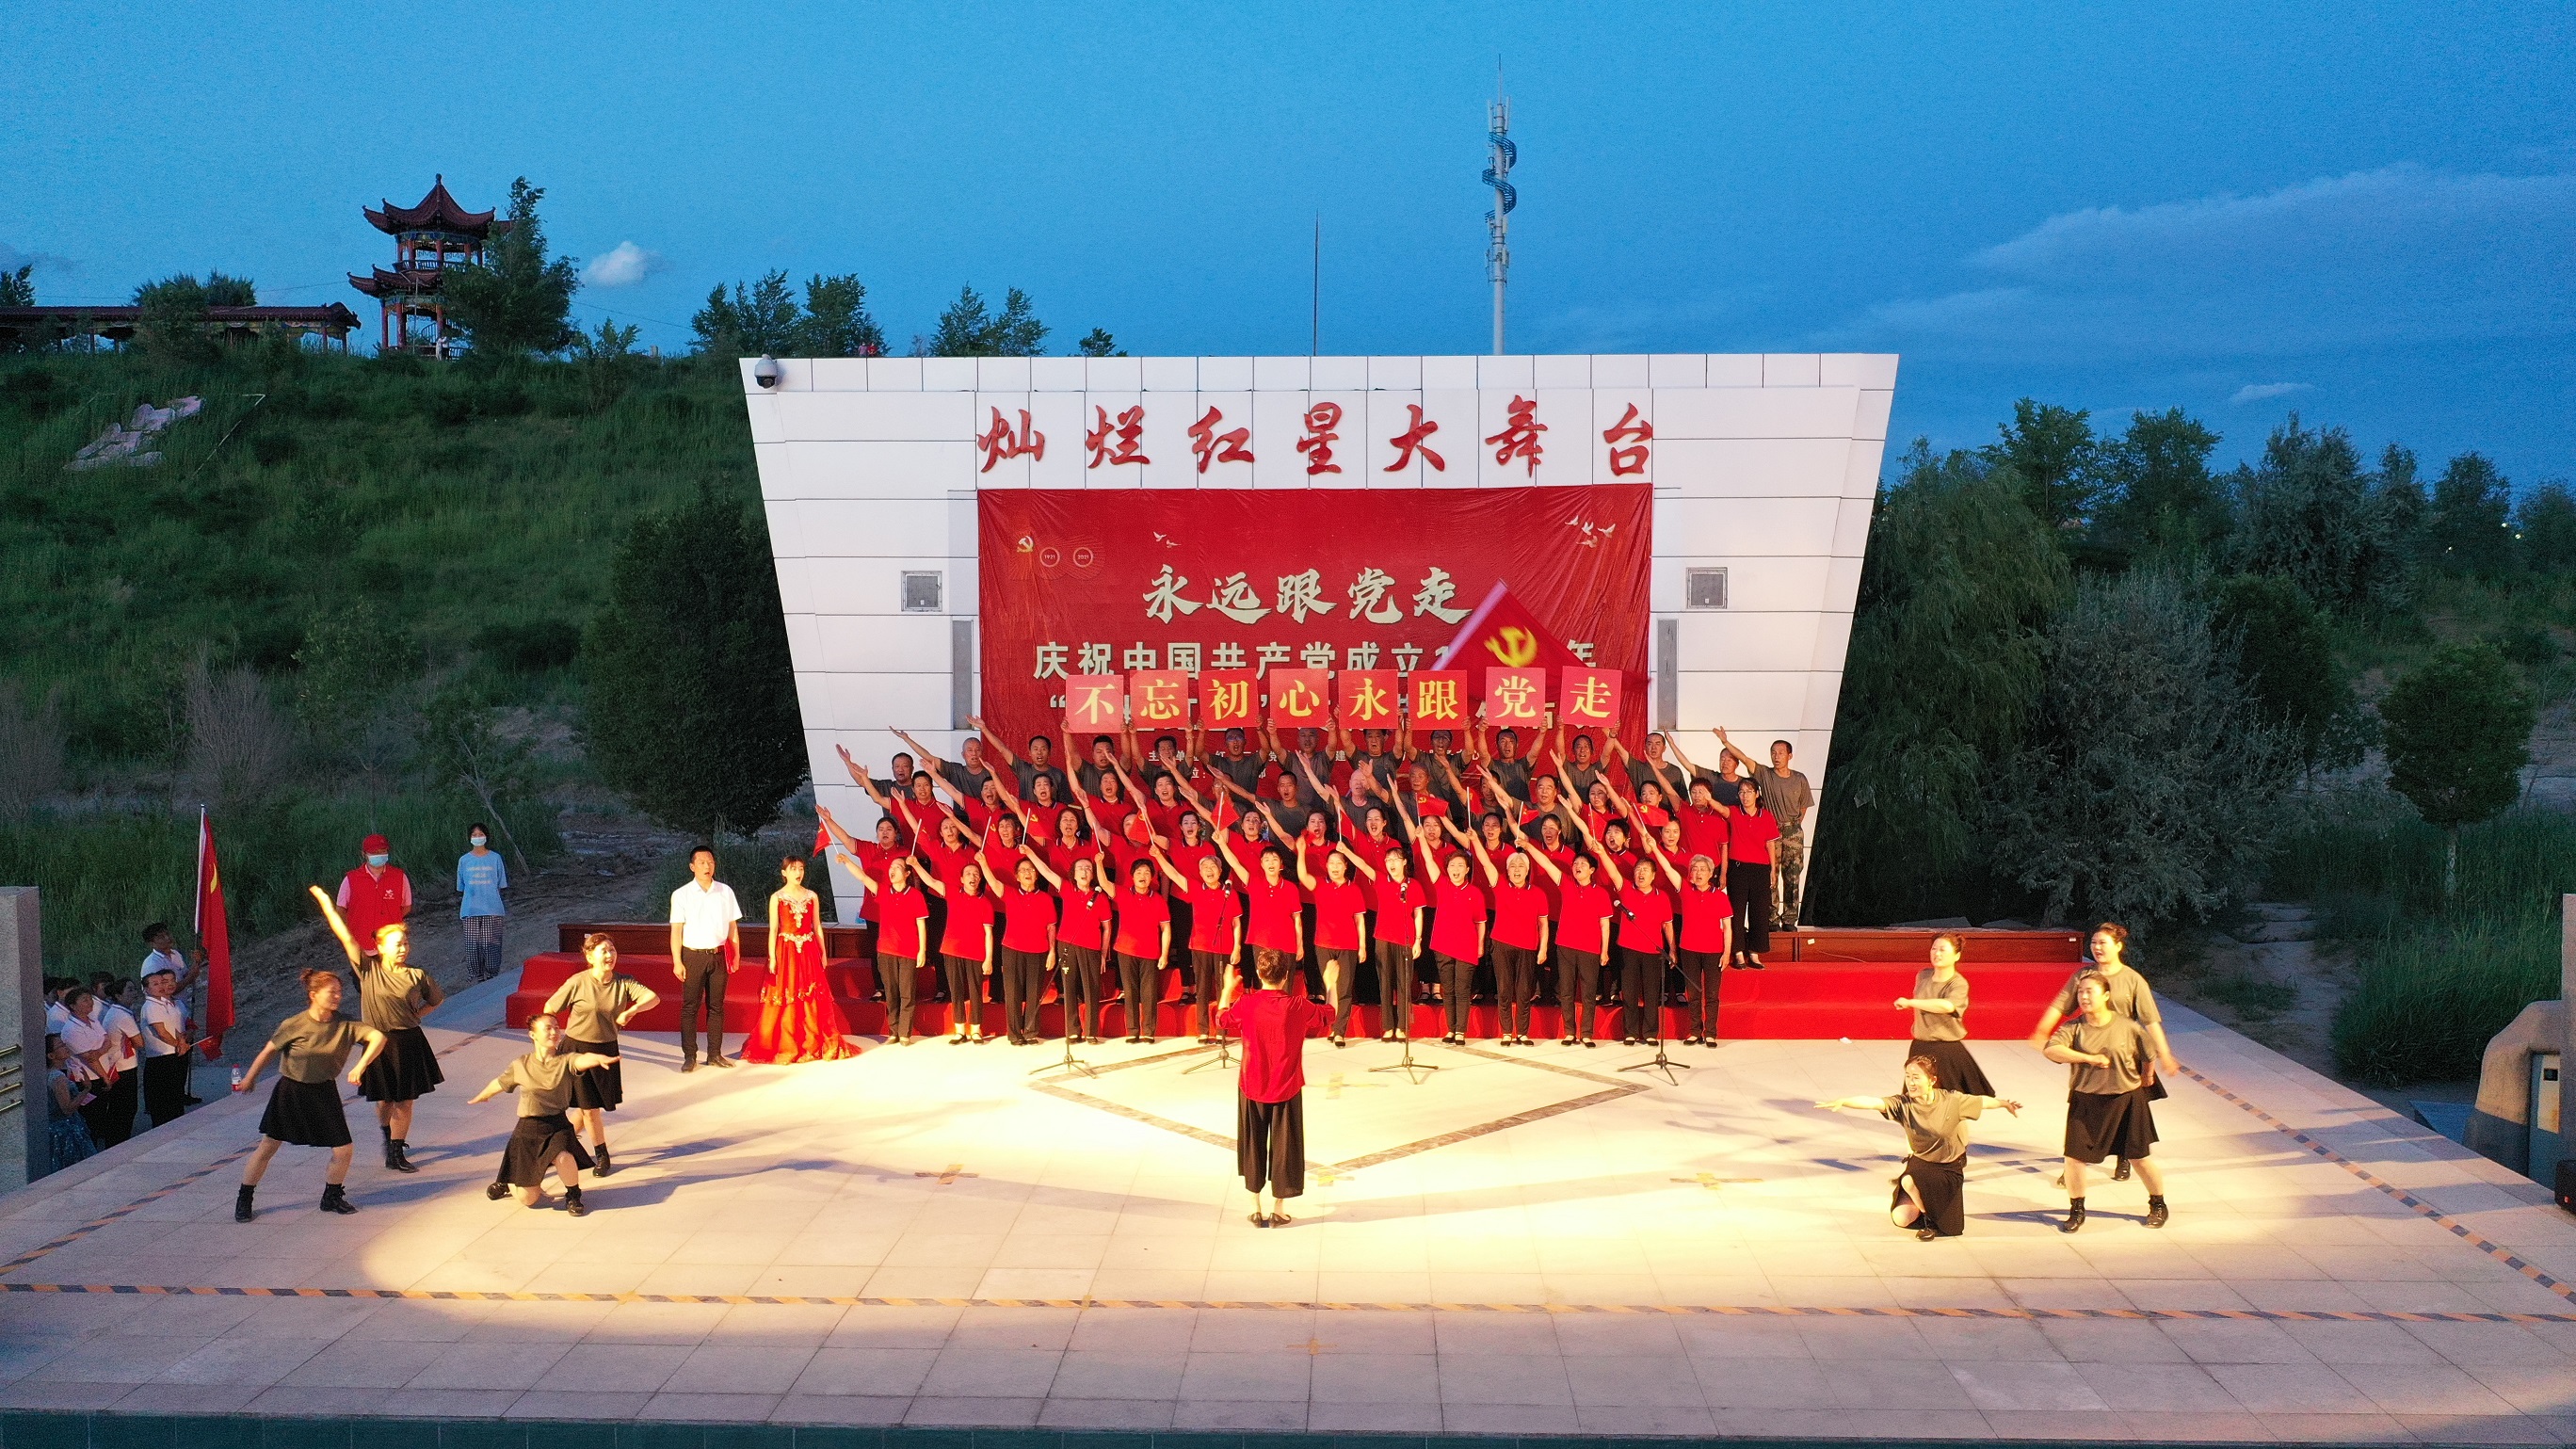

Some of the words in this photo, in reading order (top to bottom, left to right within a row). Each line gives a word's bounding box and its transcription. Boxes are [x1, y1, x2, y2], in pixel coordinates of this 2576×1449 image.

[976, 394, 1654, 478] 灿烂红星大舞台
[1142, 563, 1473, 625] 永远跟党走
[1074, 675, 1612, 725] 不忘初心永跟党走
